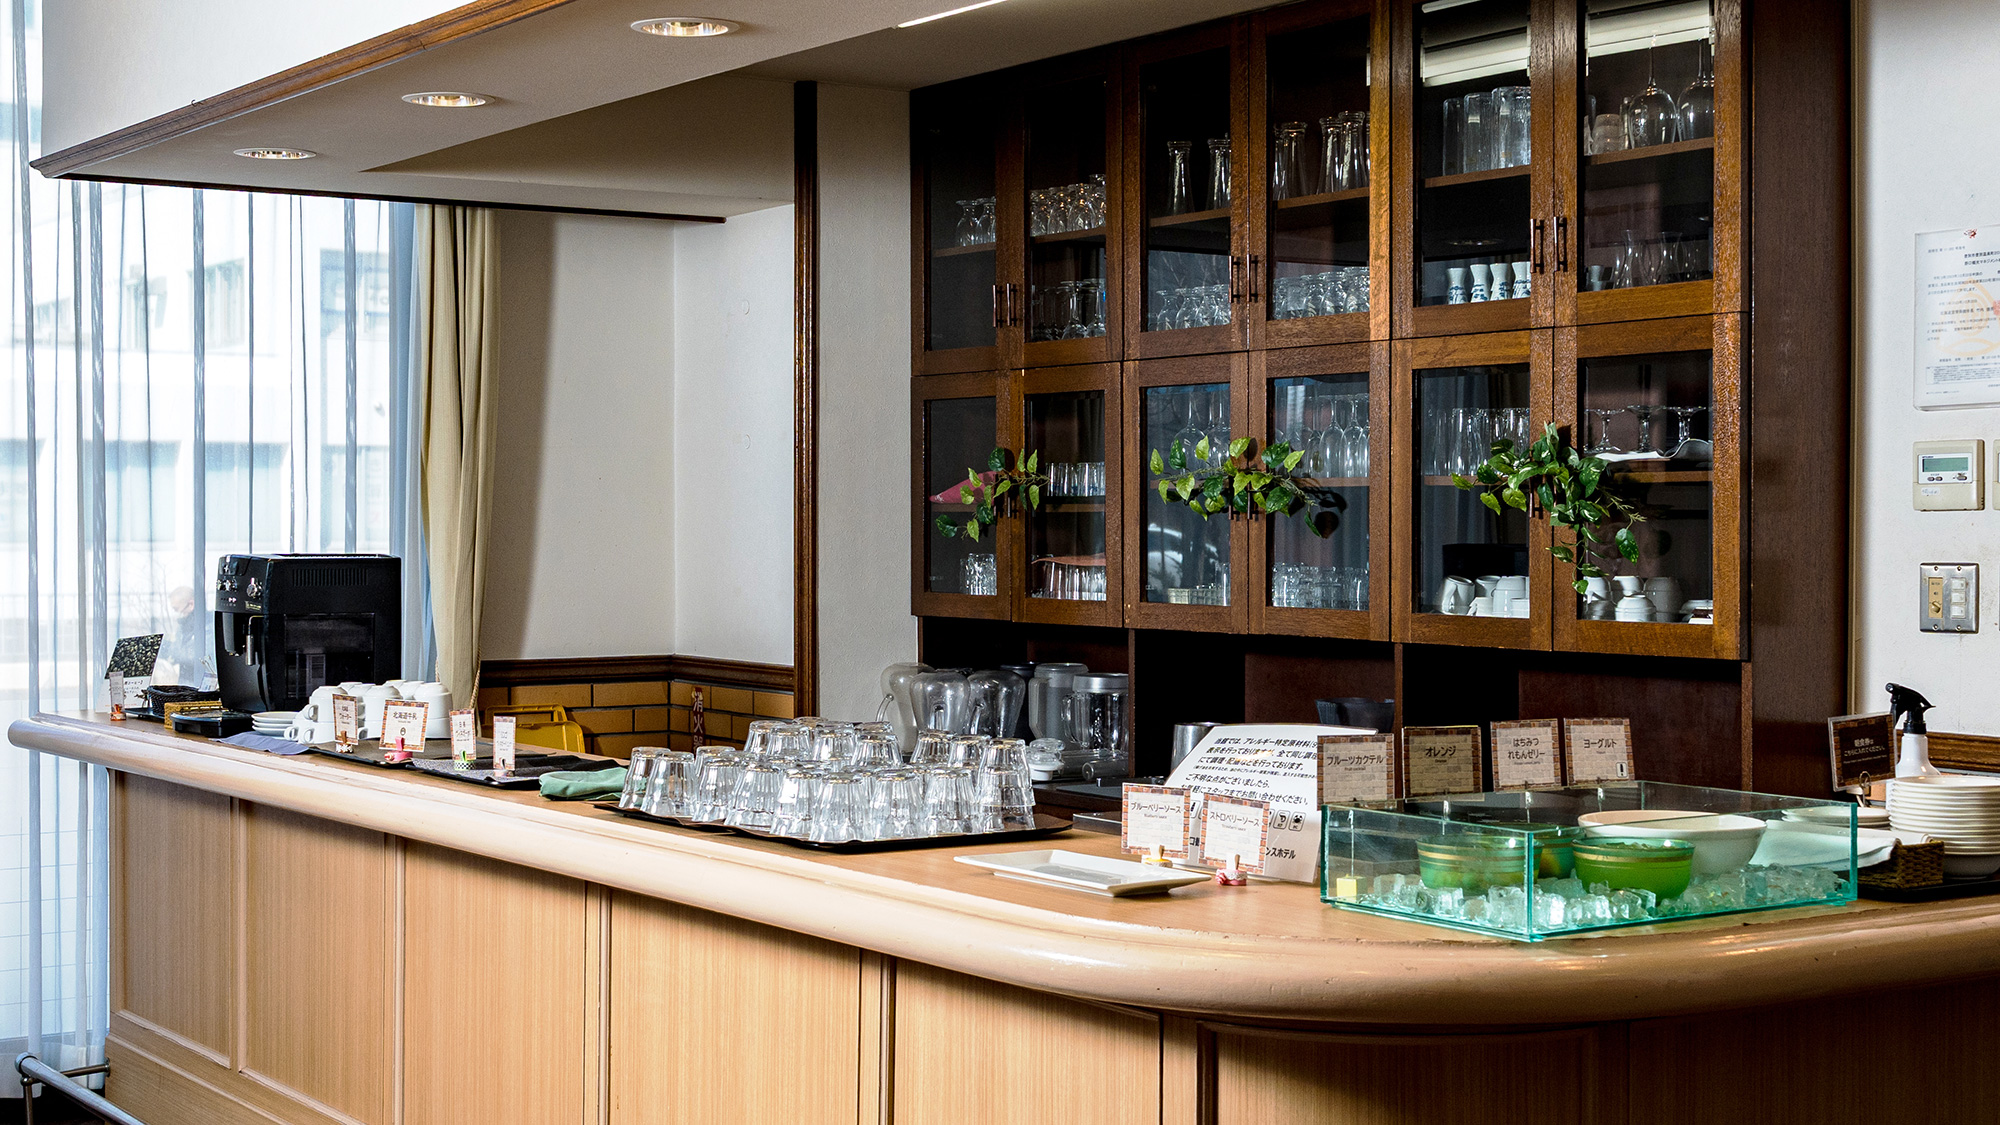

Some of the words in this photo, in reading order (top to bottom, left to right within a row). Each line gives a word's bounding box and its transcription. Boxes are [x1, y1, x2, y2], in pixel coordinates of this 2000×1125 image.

[1513, 737, 1539, 748] はちみつ
[1583, 738, 1617, 749] ヨーグルト
[1425, 745, 1456, 757] オレンジ
[1507, 749, 1545, 760] れもんゼリー
[1326, 754, 1384, 766] フルーツカクテル
[1130, 802, 1182, 814] ブルーベリーソース
[1209, 811, 1260, 827] ストロベリーソース
